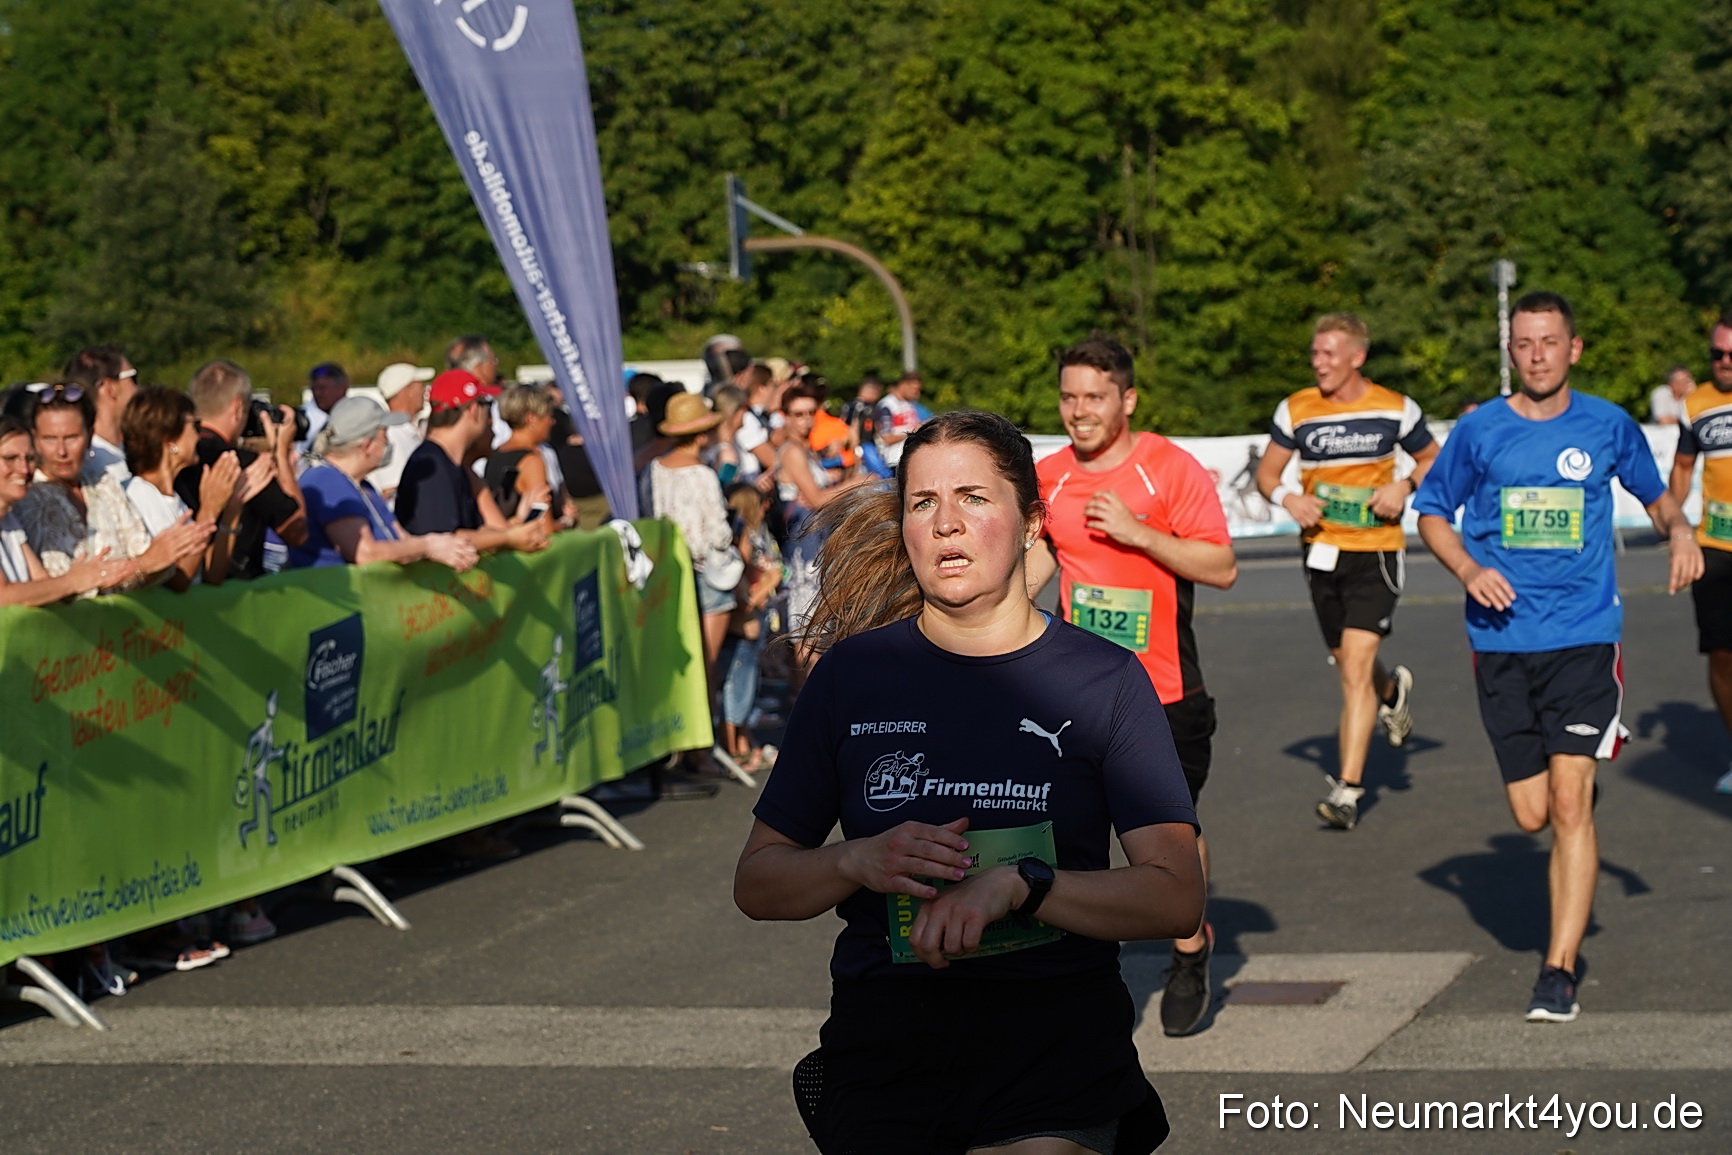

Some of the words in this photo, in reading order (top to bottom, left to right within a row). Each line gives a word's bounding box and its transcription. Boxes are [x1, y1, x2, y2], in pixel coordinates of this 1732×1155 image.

[1320, 432, 1383, 449] Fischer
[1516, 509, 1569, 528] 1759
[1087, 608, 1128, 631] 132
[31, 630, 116, 704] Gesunde
[861, 721, 927, 736] PFLEIDERER
[280, 689, 405, 807] firmenlauf
[922, 778, 1053, 801] Firmenlauf
[972, 797, 1049, 812] neumarkt
[897, 893, 913, 938] RUN
